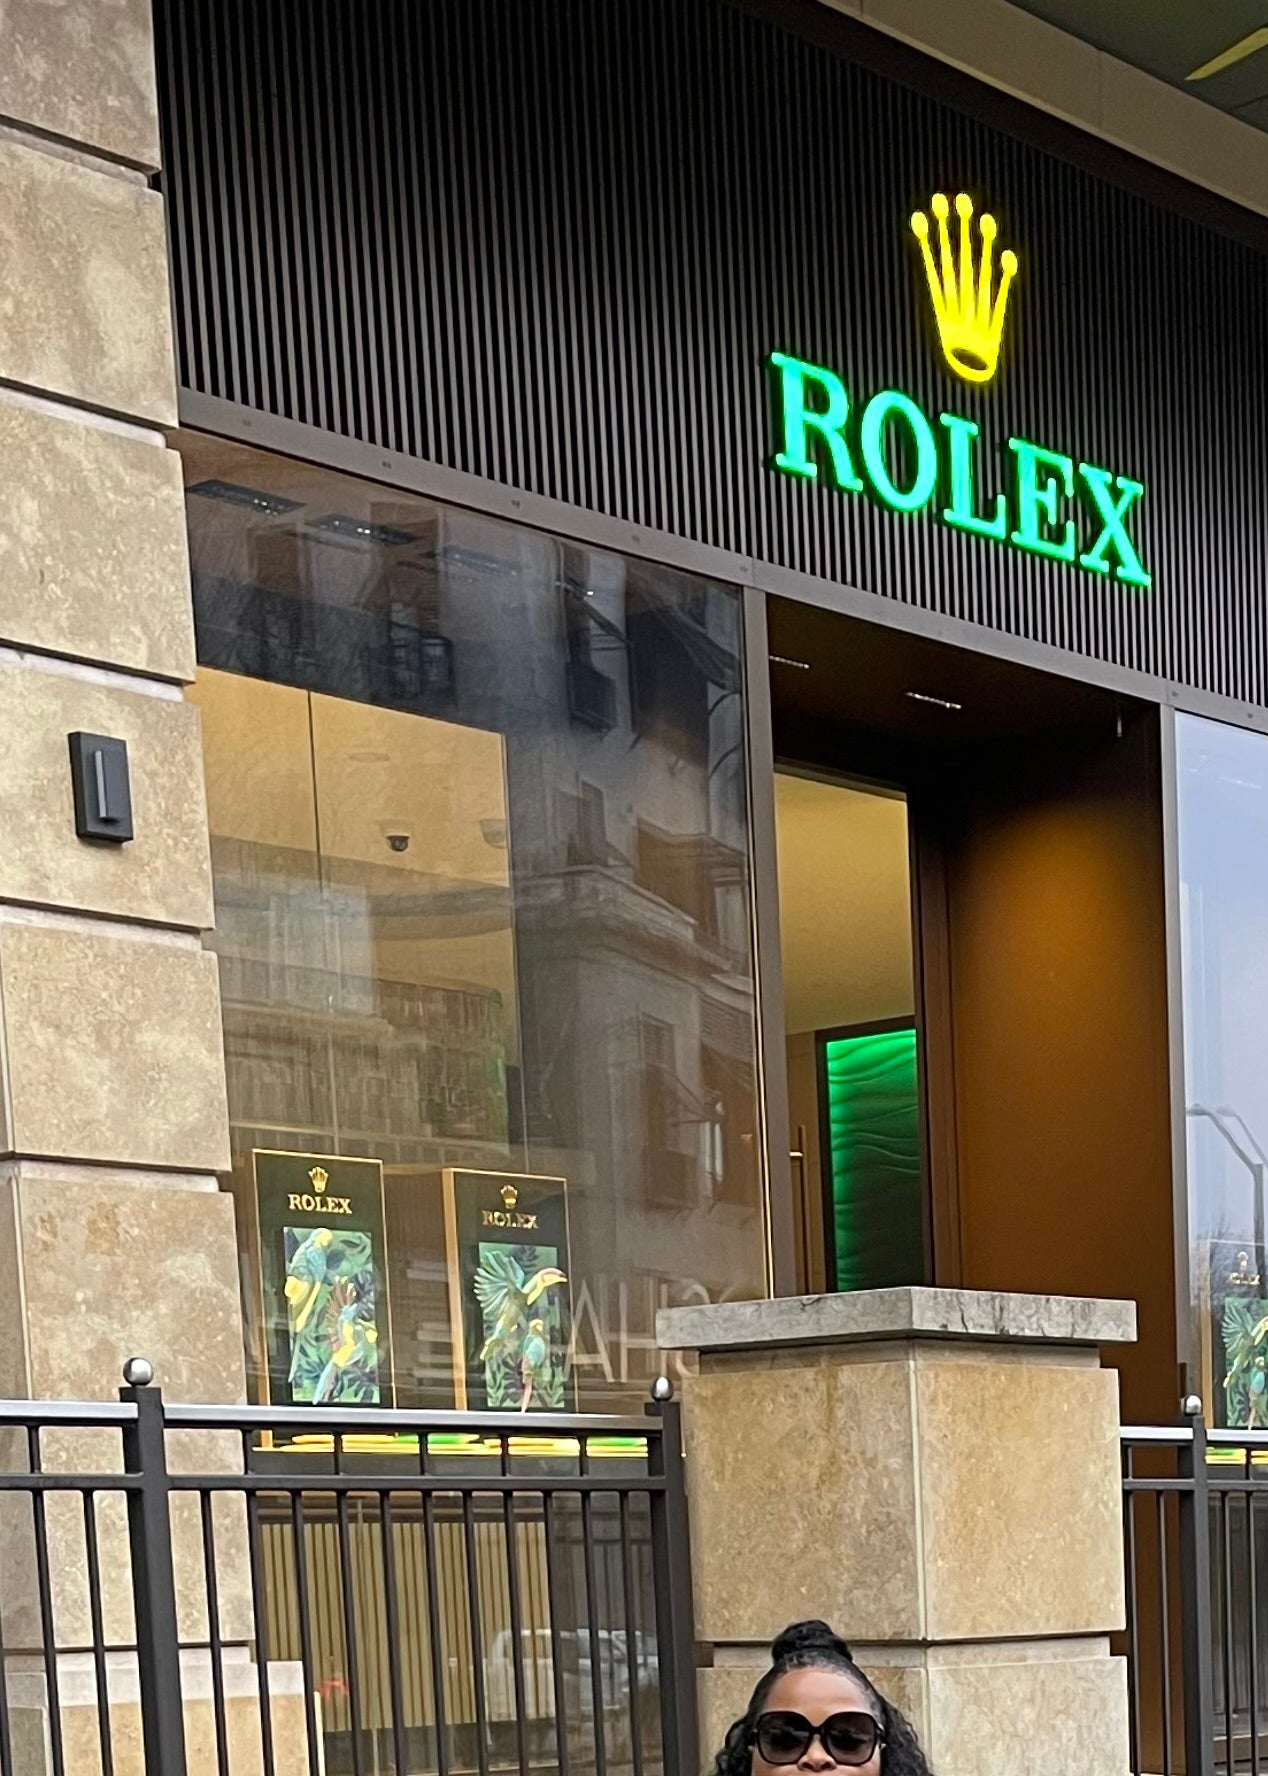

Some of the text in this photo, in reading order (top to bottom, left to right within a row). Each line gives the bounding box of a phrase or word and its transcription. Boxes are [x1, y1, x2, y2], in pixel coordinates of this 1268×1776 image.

[770, 351, 1152, 588] ROLEX
[287, 1194, 353, 1214] ROLEX
[482, 1210, 539, 1229] ROLEX
